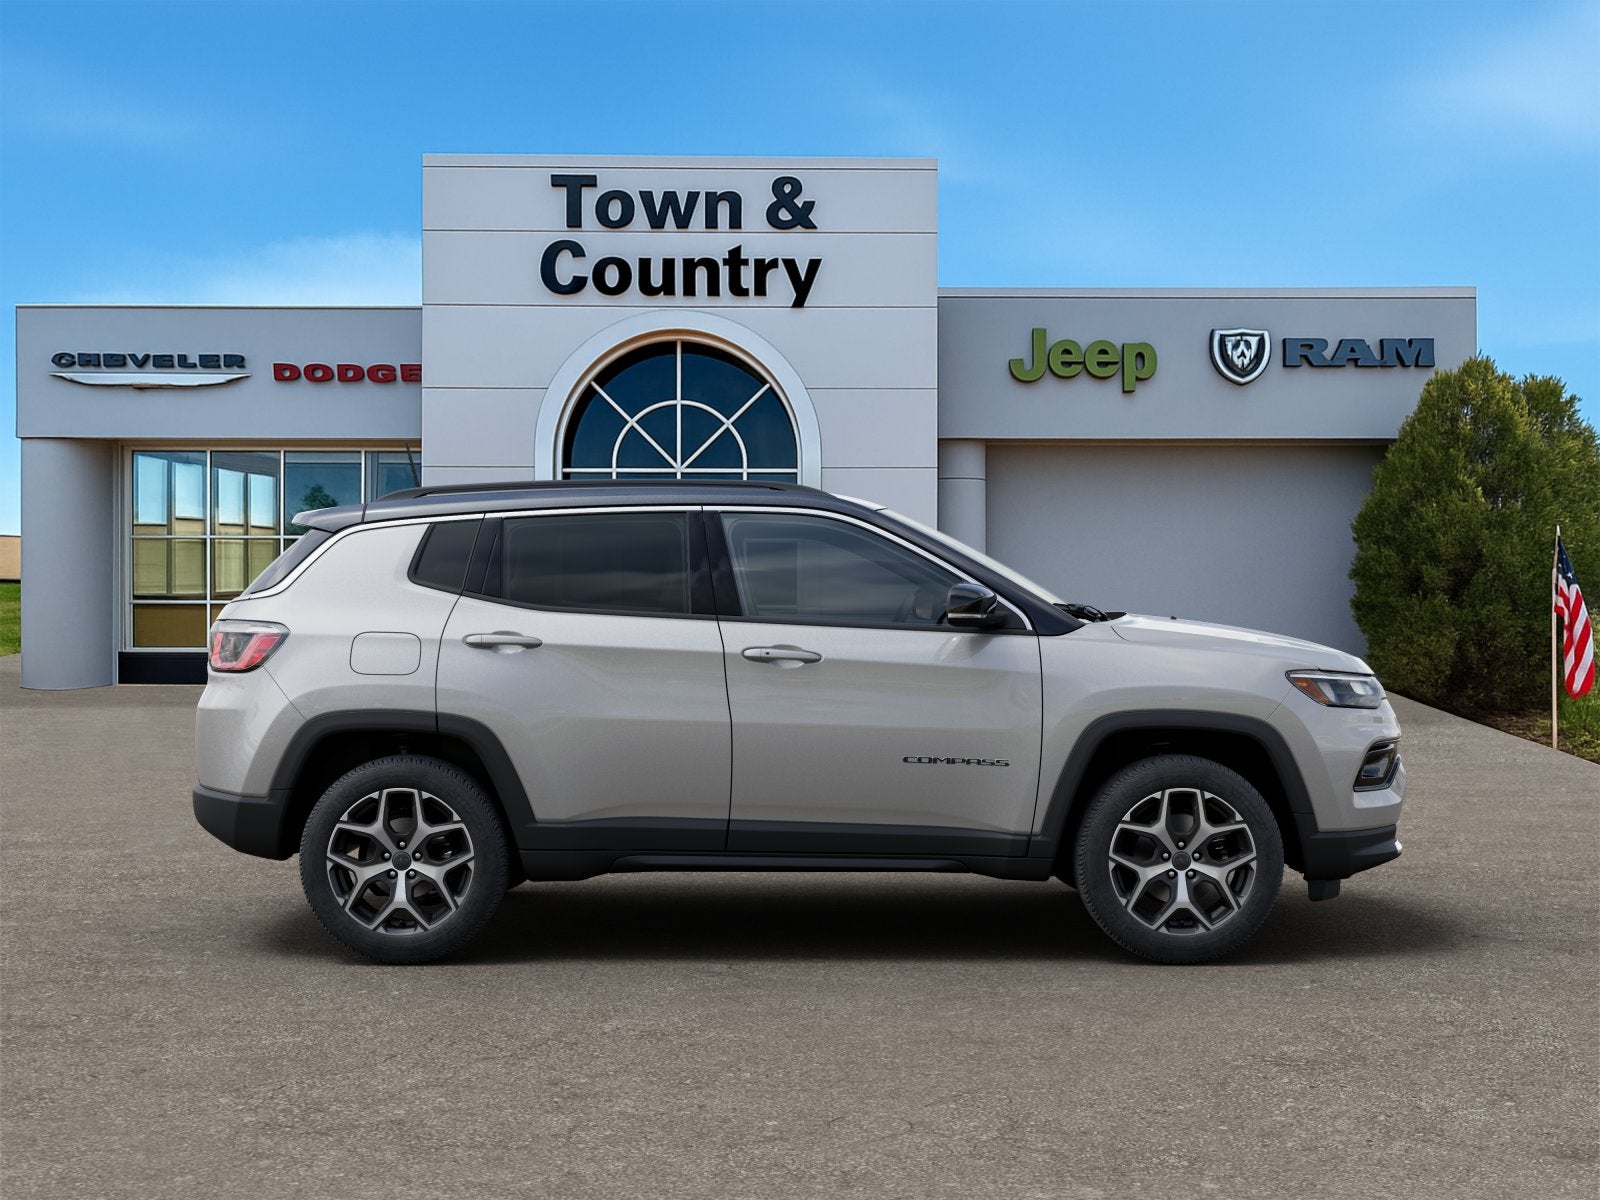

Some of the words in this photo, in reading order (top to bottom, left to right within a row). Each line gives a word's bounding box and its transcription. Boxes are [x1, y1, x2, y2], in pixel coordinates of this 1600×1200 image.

[550, 174, 743, 230] Town
[765, 175, 818, 230] &
[540, 239, 823, 309] Country
[272, 363, 422, 383] DODGE
[1009, 327, 1158, 394] Jeep
[1282, 337, 1436, 368] RAM
[902, 756, 1010, 767] COMPASS
